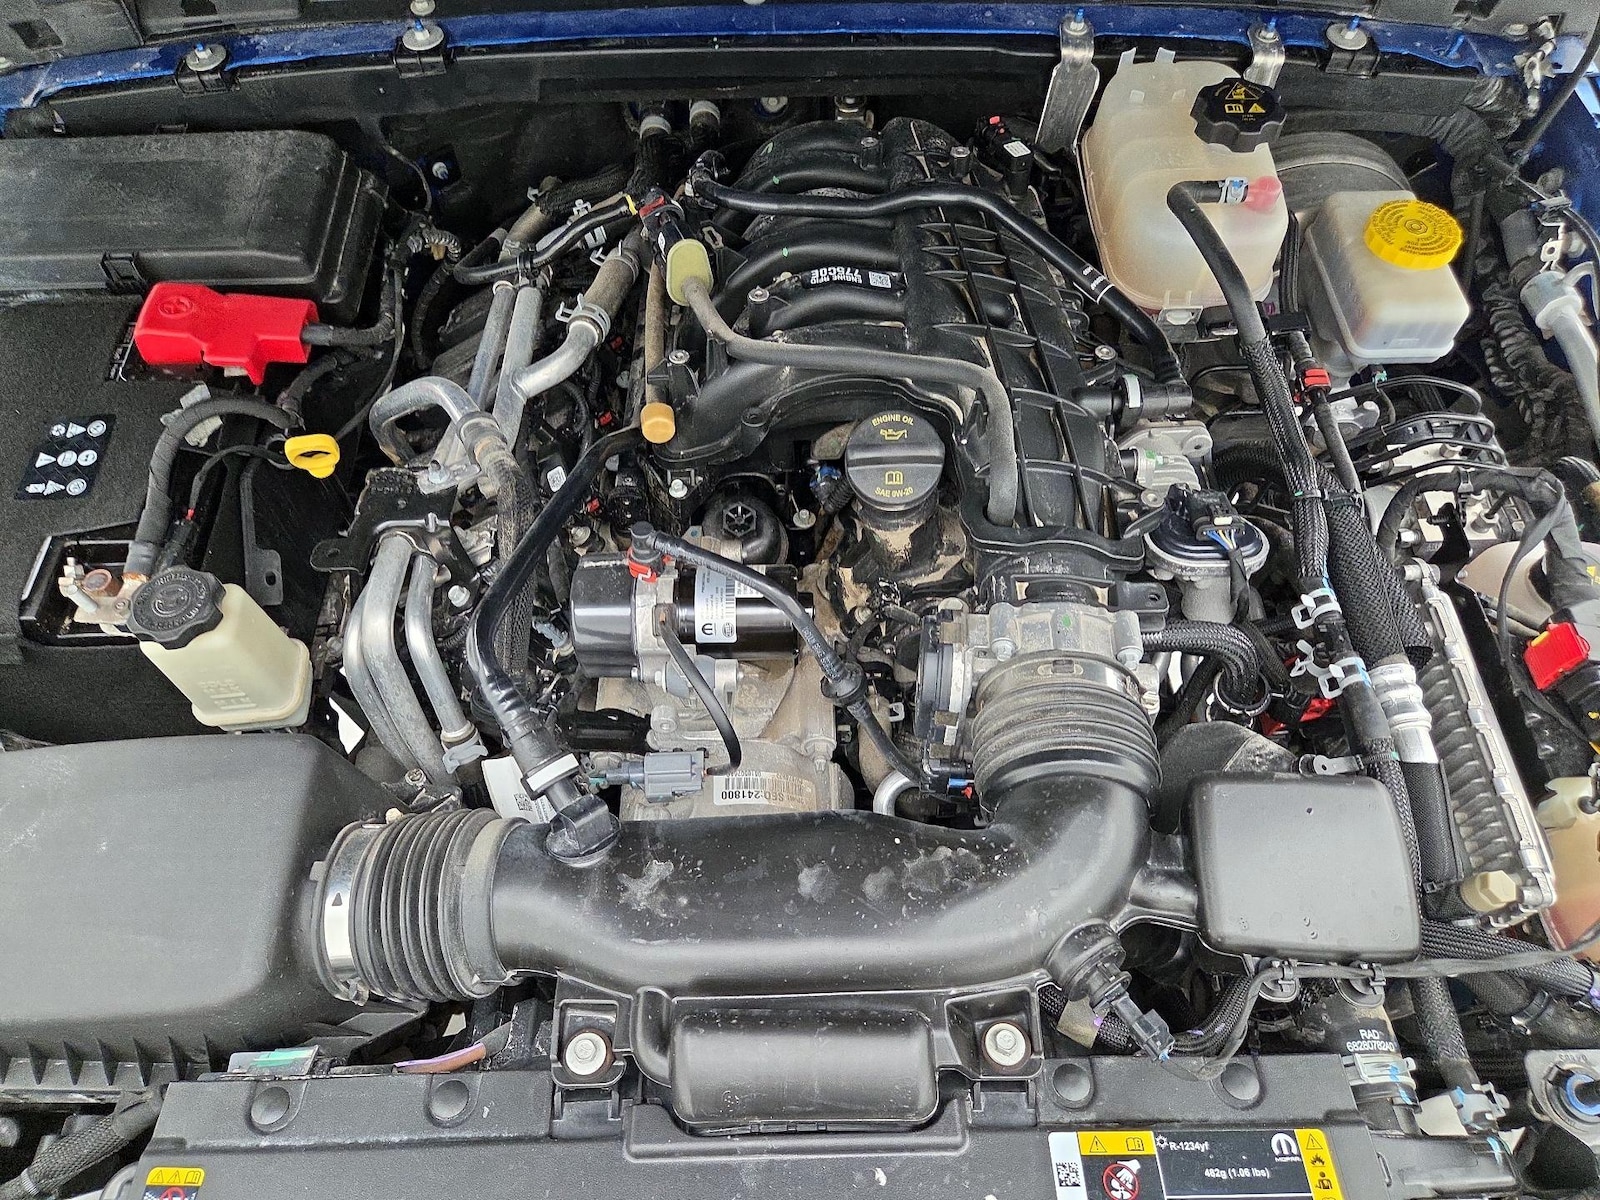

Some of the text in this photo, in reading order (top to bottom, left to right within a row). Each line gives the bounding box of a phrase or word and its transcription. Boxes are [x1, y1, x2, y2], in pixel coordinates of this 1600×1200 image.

[832, 273, 863, 284] ENGINE
[871, 413, 914, 427] ENGINE OIL
[874, 486, 891, 498] SAE
[1359, 1029, 1380, 1040] RAD
[1169, 1141, 1210, 1153] R-1234yf
[1228, 1167, 1251, 1180] (1.06
[1251, 1167, 1270, 1180] lbs)
